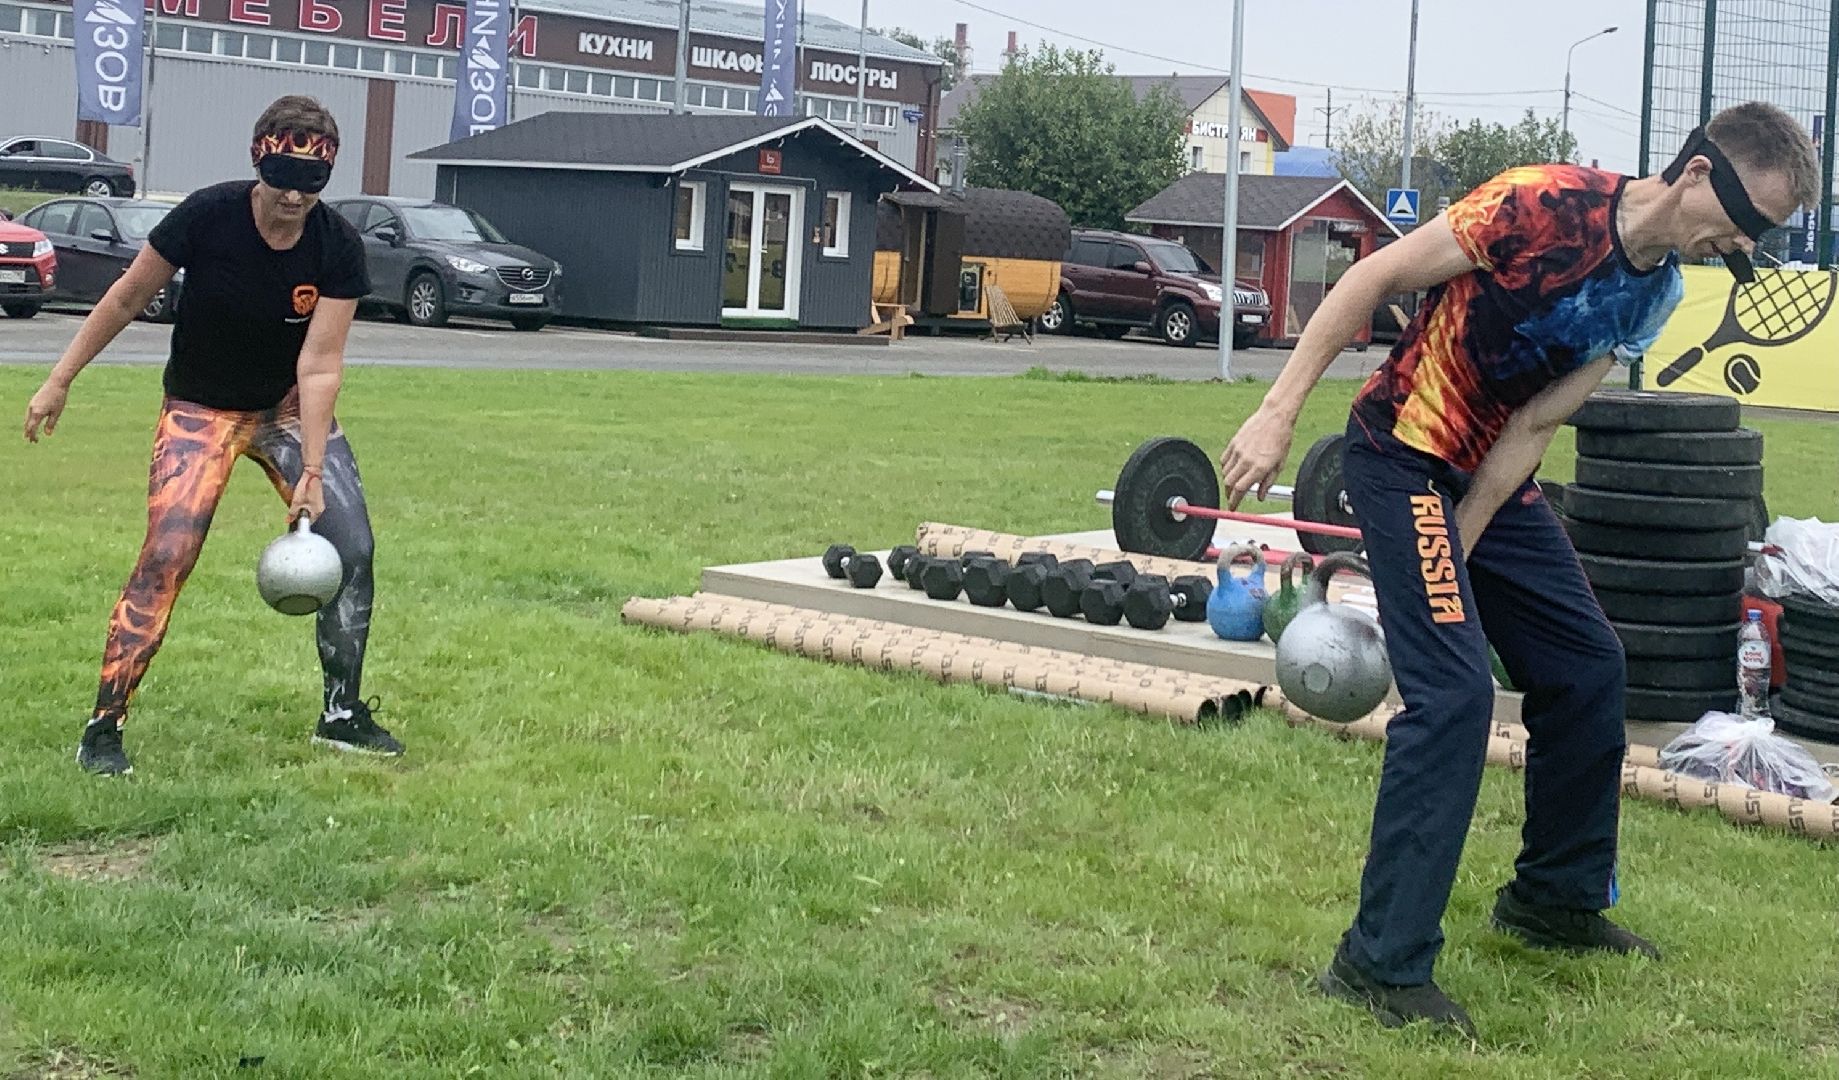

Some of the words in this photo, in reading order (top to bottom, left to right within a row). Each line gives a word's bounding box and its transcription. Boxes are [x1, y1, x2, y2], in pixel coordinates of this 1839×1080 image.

[578, 31, 654, 62] КУХНИ
[1192, 120, 1229, 139] БИСТР
[1409, 495, 1466, 624] RUSSIA
